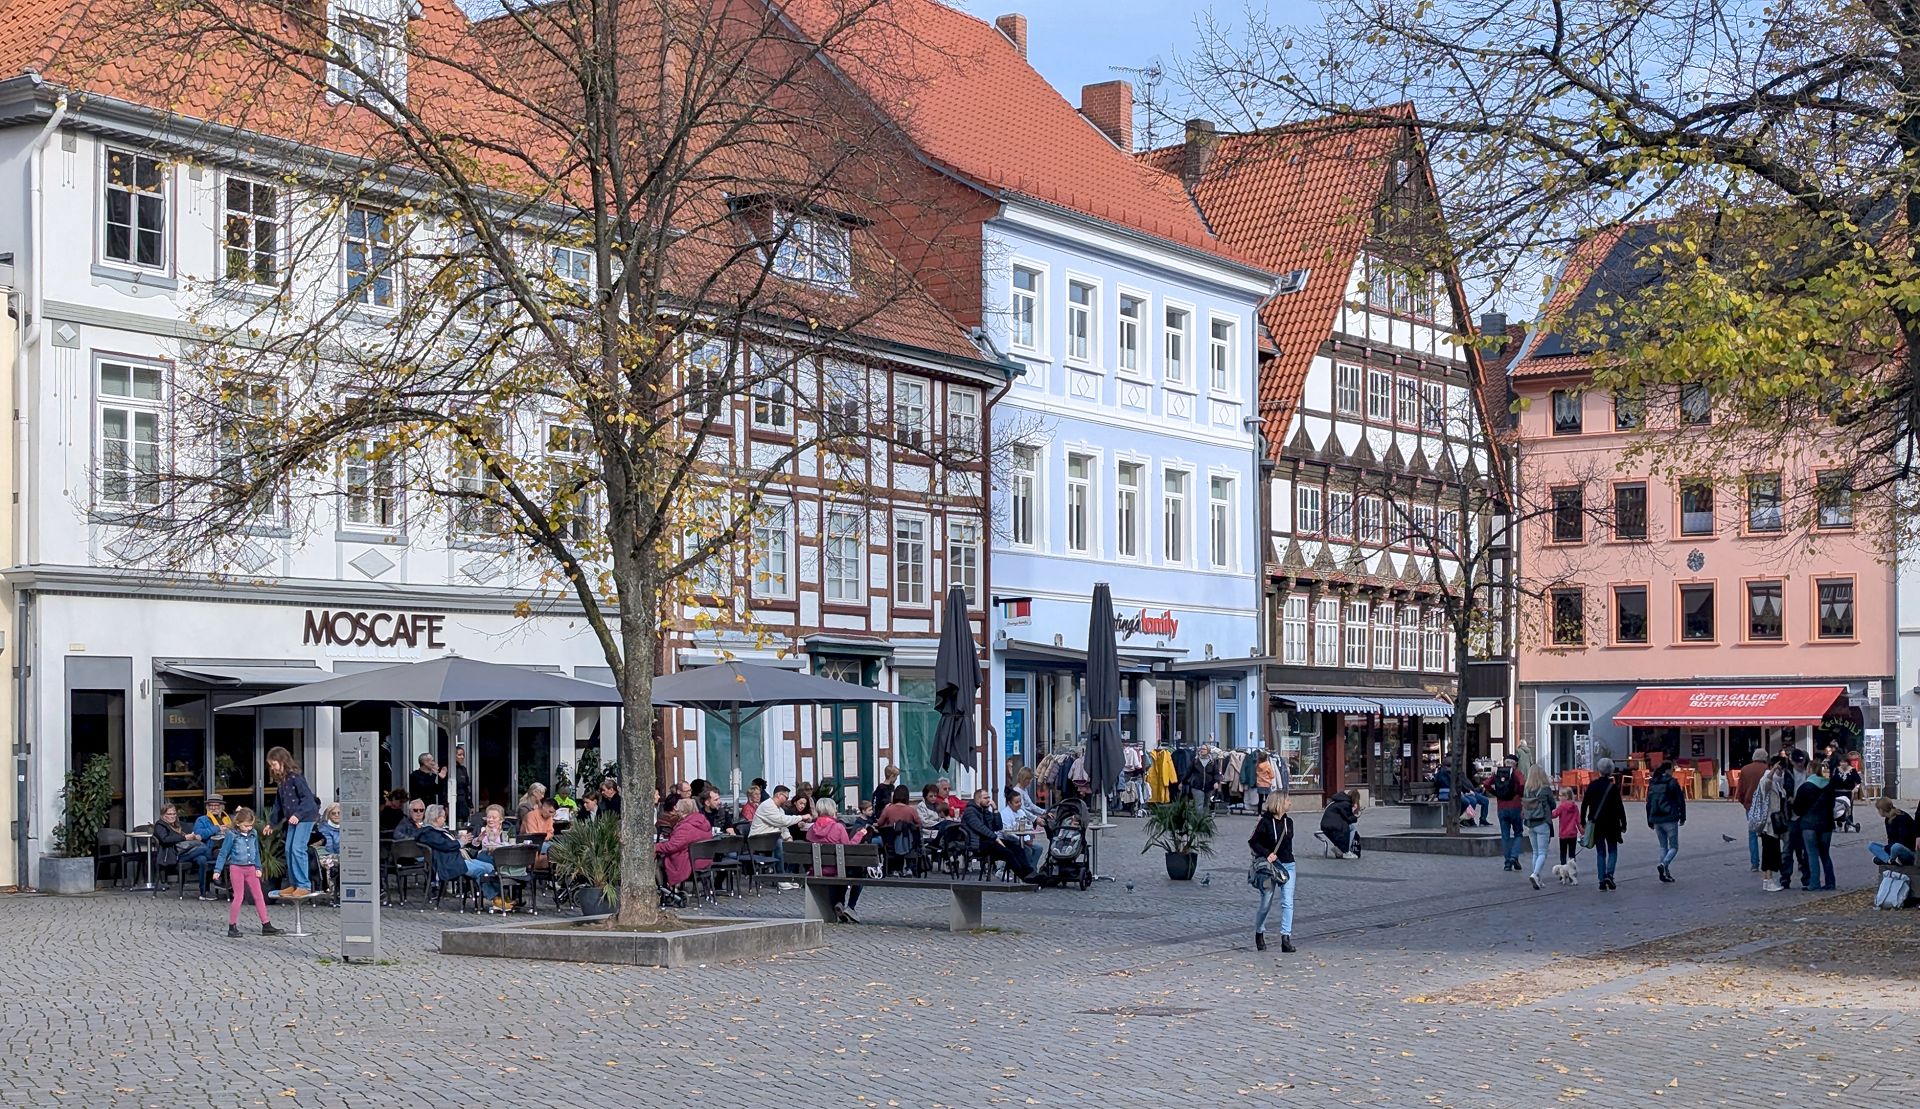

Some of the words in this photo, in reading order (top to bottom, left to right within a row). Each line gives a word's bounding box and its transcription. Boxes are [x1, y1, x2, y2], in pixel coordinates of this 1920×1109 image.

[303, 609, 446, 649] MOSCAFE
[1140, 608, 1178, 640] family
[1688, 692, 1779, 702] LÖFFELGALERIE
[1688, 699, 1768, 708] BISTRONOMIE
